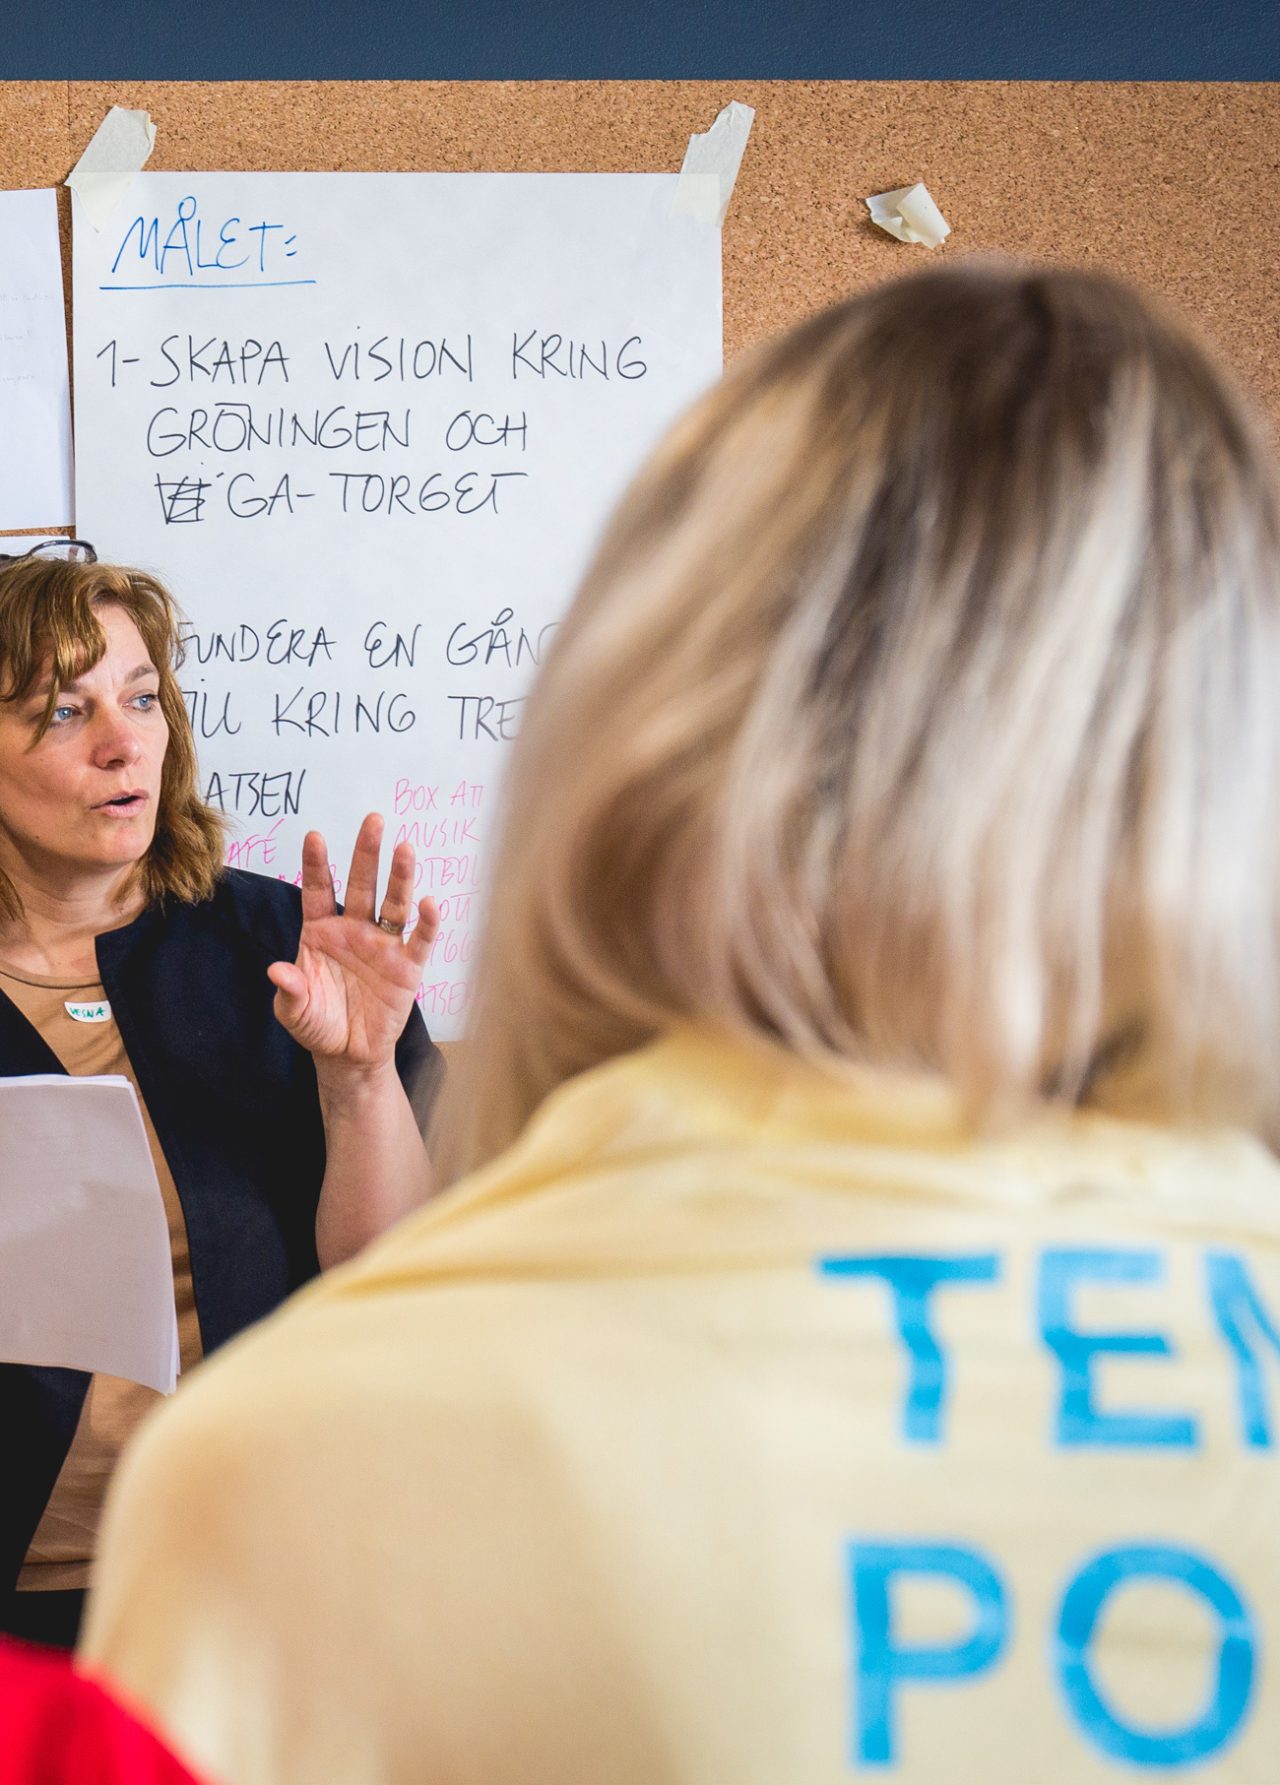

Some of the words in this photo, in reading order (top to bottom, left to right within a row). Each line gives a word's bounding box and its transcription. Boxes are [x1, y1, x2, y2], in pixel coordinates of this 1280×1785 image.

[111, 196, 298, 276] MÅLET:
[150, 335, 291, 387] SKAPA
[513, 329, 648, 381] KRING
[445, 410, 528, 452] OCH
[365, 622, 422, 668] EN
[446, 607, 561, 668] GÅN
[271, 686, 416, 738] KRING
[204, 769, 307, 817] ATSEN
[394, 778, 440, 815] BOX
[226, 818, 286, 870] AFÉ
[393, 817, 481, 849] MUSIK
[844, 1538, 1260, 1772] PO
